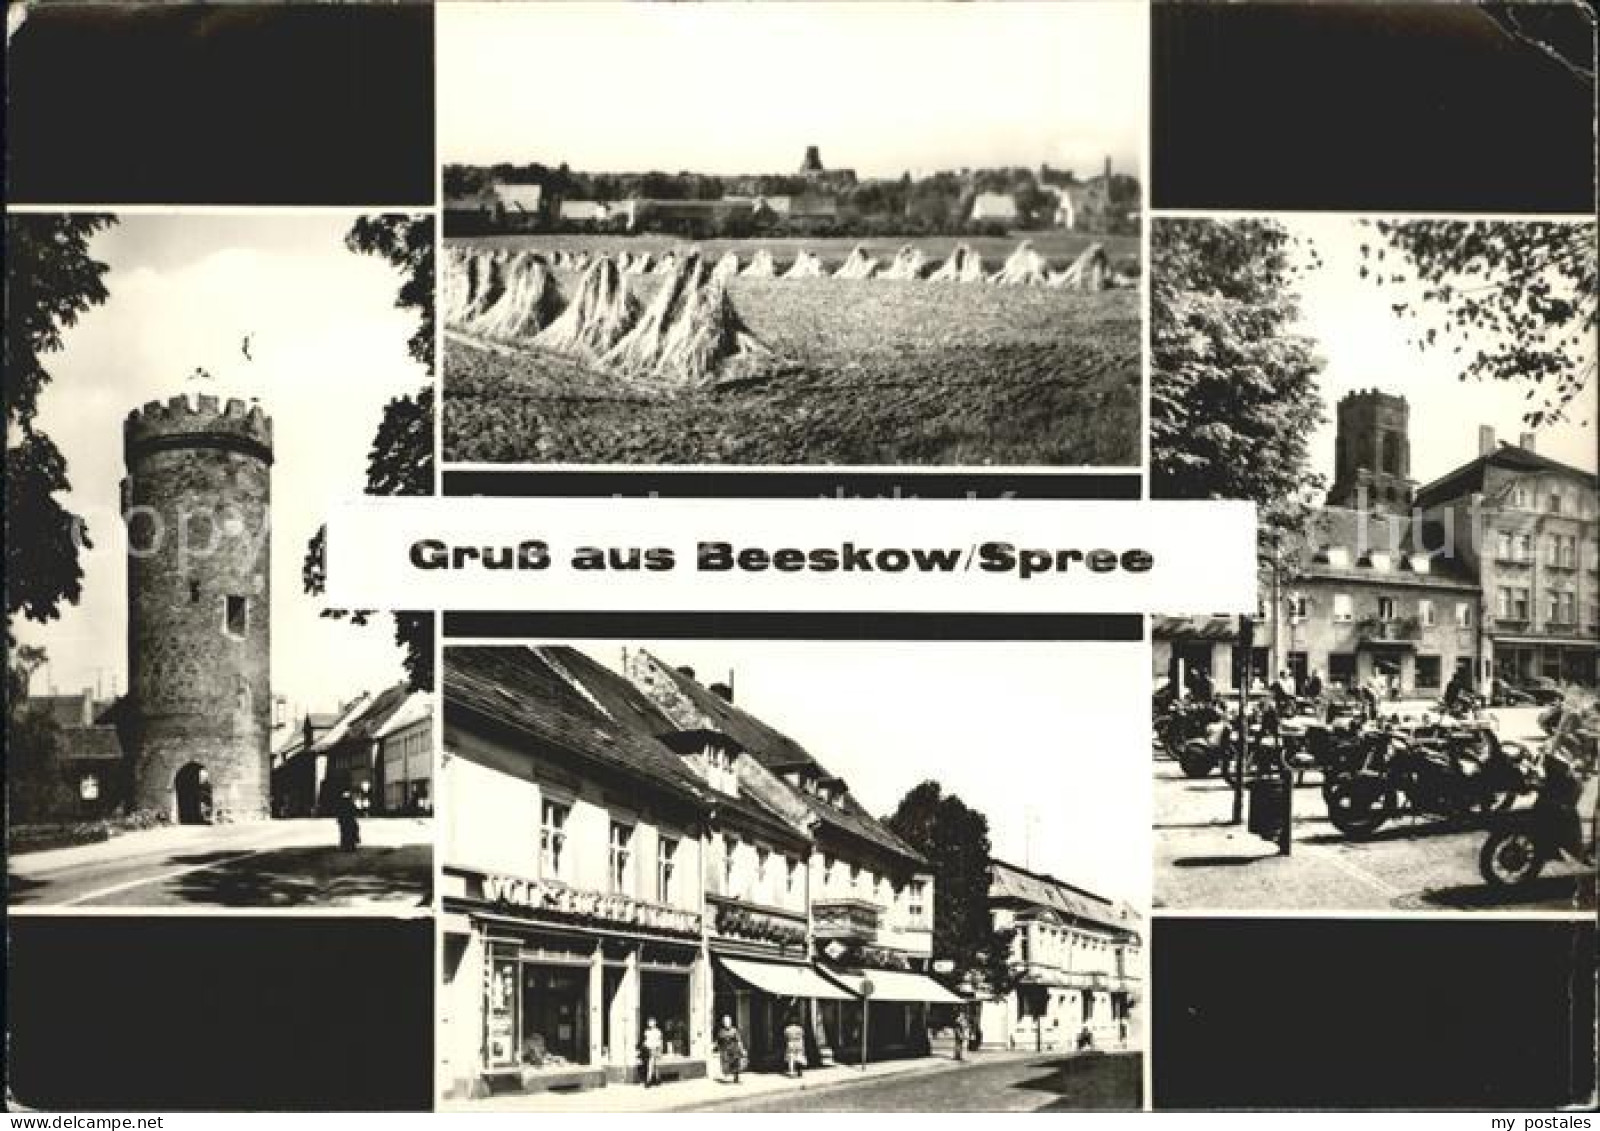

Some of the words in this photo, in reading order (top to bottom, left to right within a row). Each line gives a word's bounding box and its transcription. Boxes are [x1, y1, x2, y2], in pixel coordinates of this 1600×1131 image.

[408, 538, 552, 570] Gruß
[570, 546, 676, 572] aus
[696, 541, 1154, 579] Beeskow/Spree
